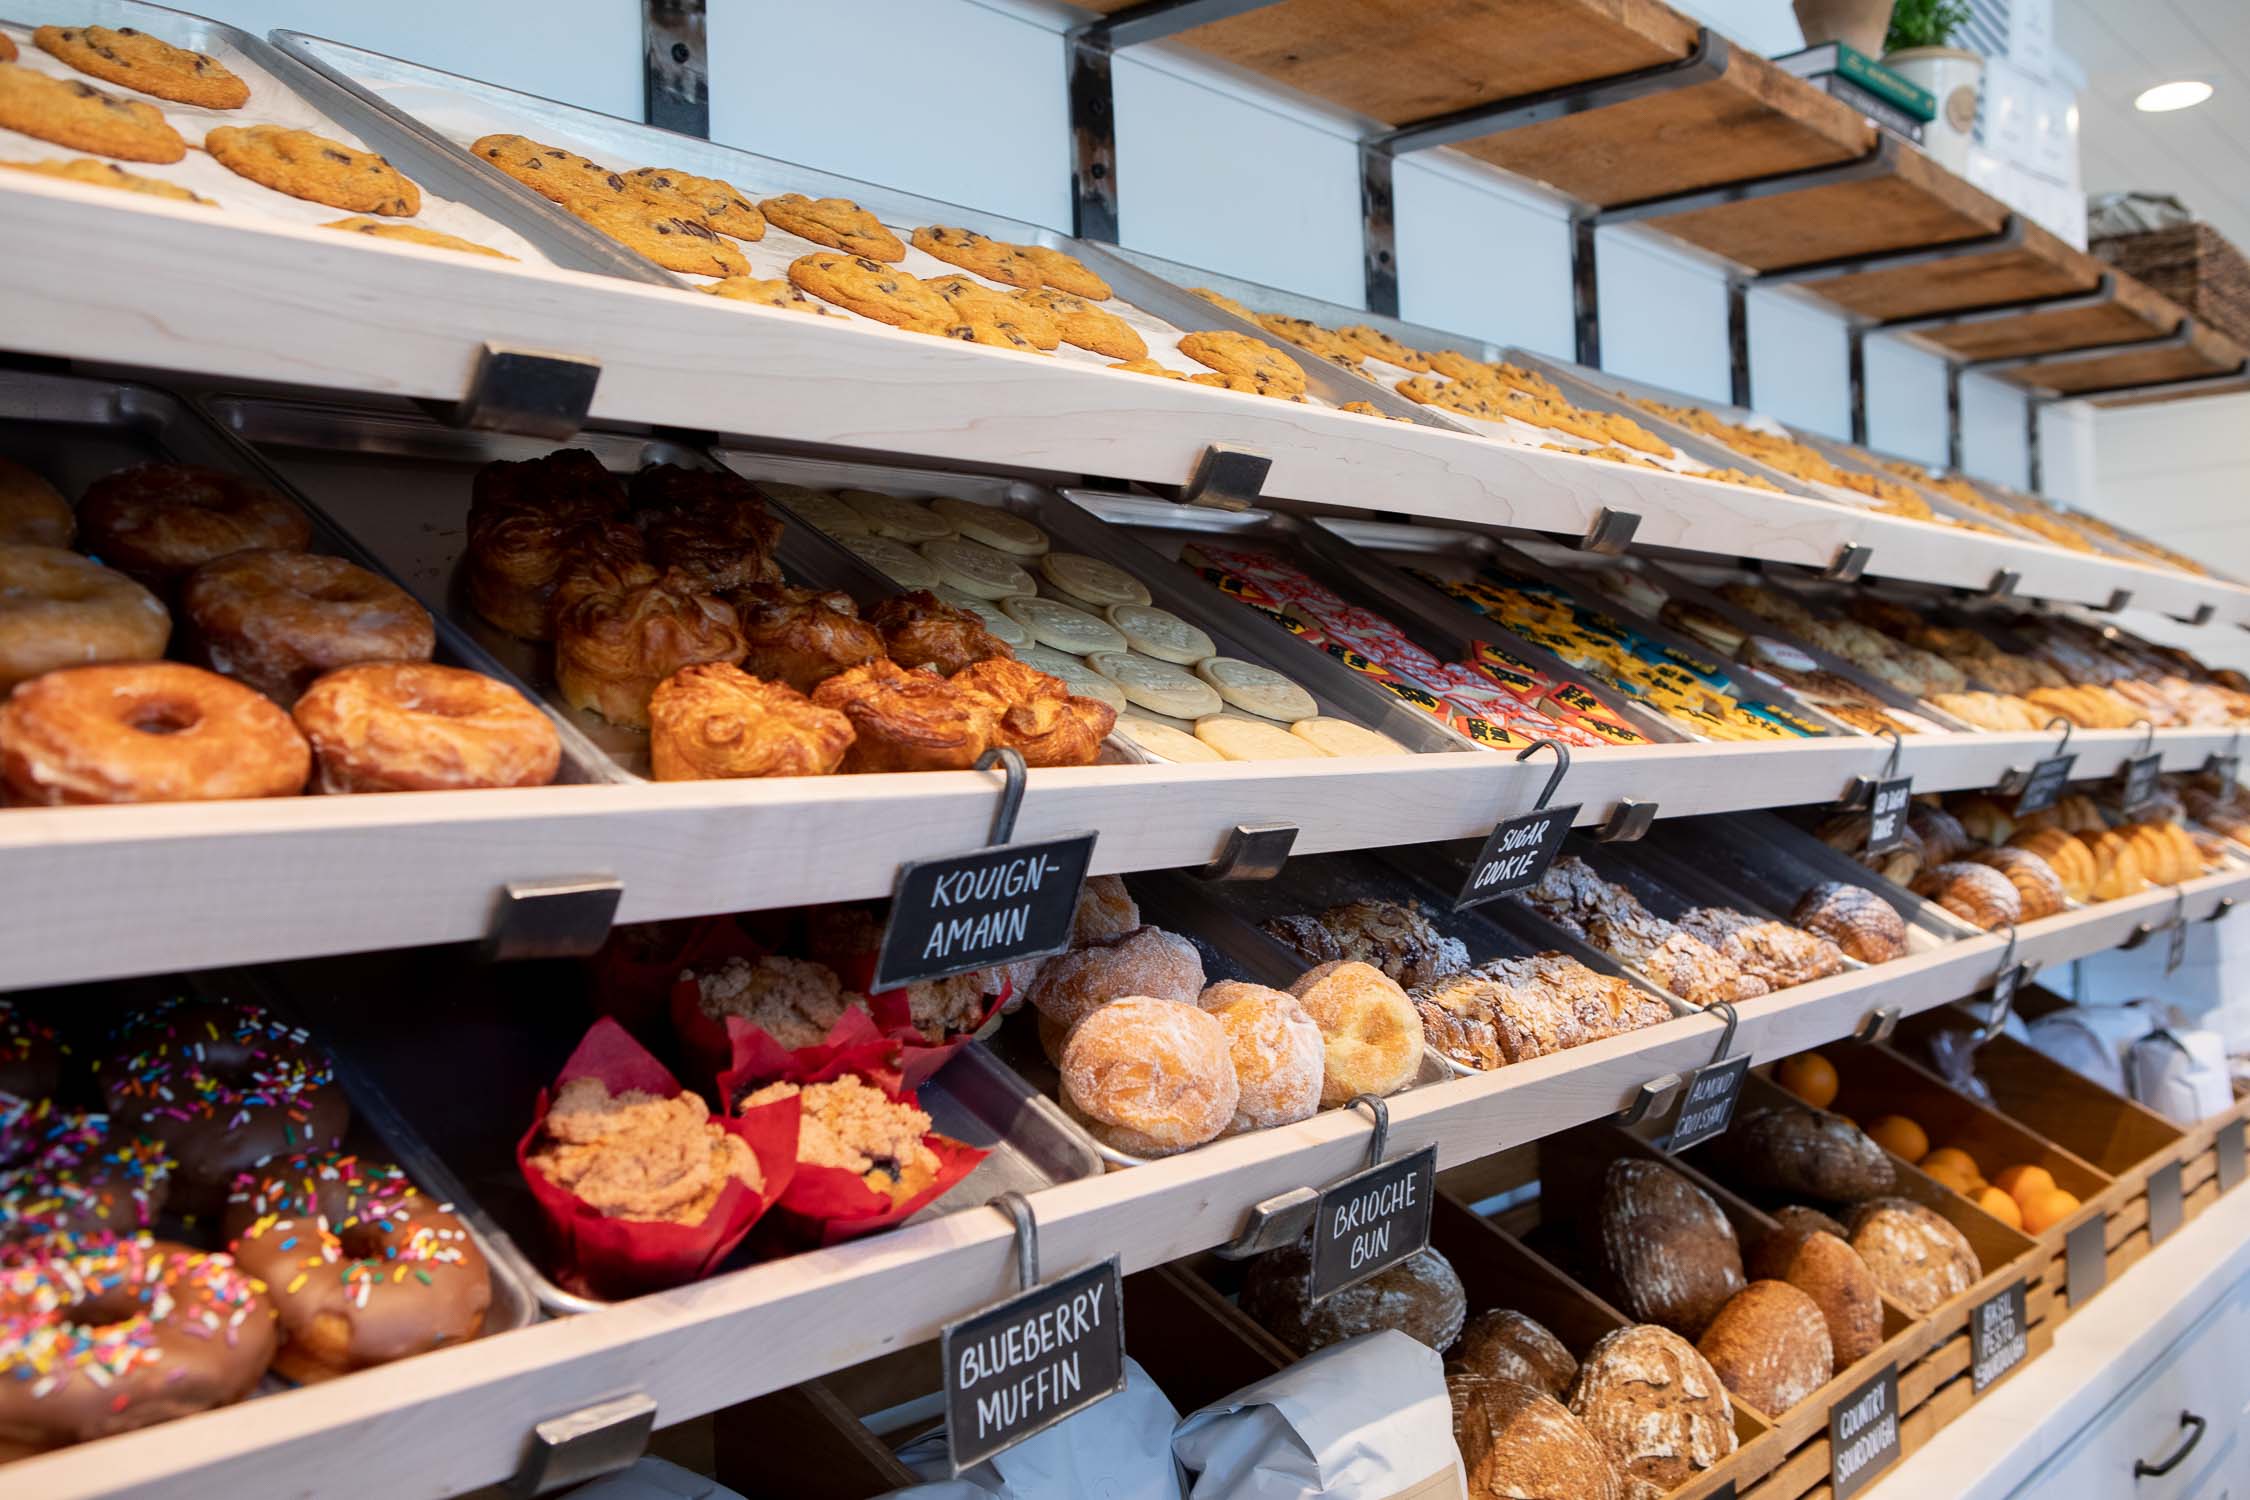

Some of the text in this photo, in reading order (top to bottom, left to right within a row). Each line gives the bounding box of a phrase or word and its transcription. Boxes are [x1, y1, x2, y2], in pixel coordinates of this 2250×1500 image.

[1498, 819, 1551, 853] SUGAR
[930, 853, 1060, 908] KOUIGN-
[1473, 850, 1539, 890] COOKIE
[922, 904, 1031, 960] AMANN
[1689, 1071, 1735, 1104] ALMOND
[1333, 1172, 1417, 1240] BRIOCHE
[1350, 1220, 1391, 1270] BUN
[959, 1282, 1104, 1390] BLUEBERRY
[976, 1351, 1082, 1440] MUFFIN
[1840, 1381, 1886, 1440] COUNTRY
